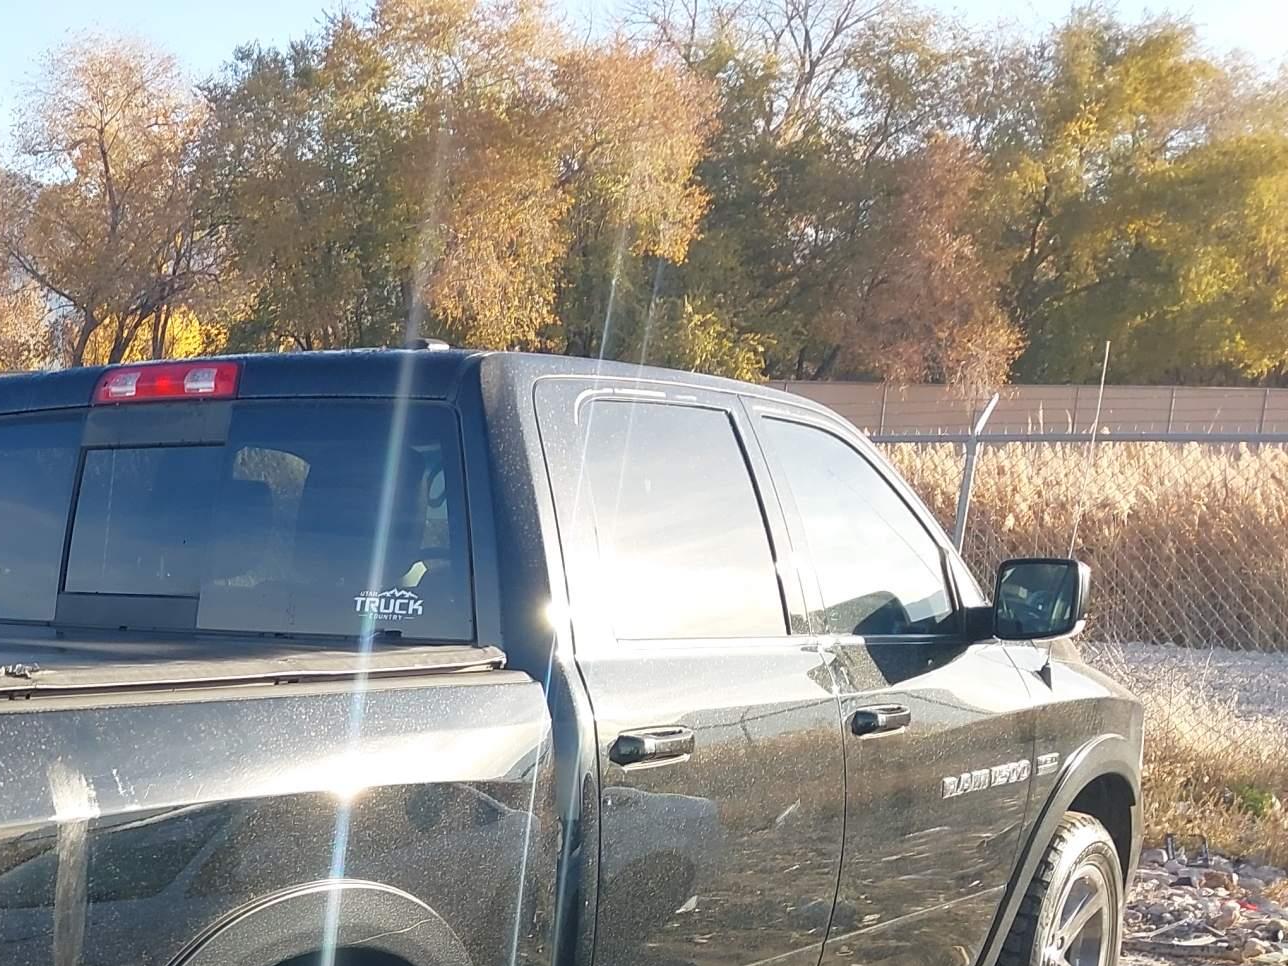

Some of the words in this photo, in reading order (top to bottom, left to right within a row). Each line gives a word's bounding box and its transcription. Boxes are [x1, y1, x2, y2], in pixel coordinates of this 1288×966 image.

[354, 597, 424, 615] TRUCK
[368, 613, 403, 621] COUNTRY
[941, 768, 990, 799] RAM
